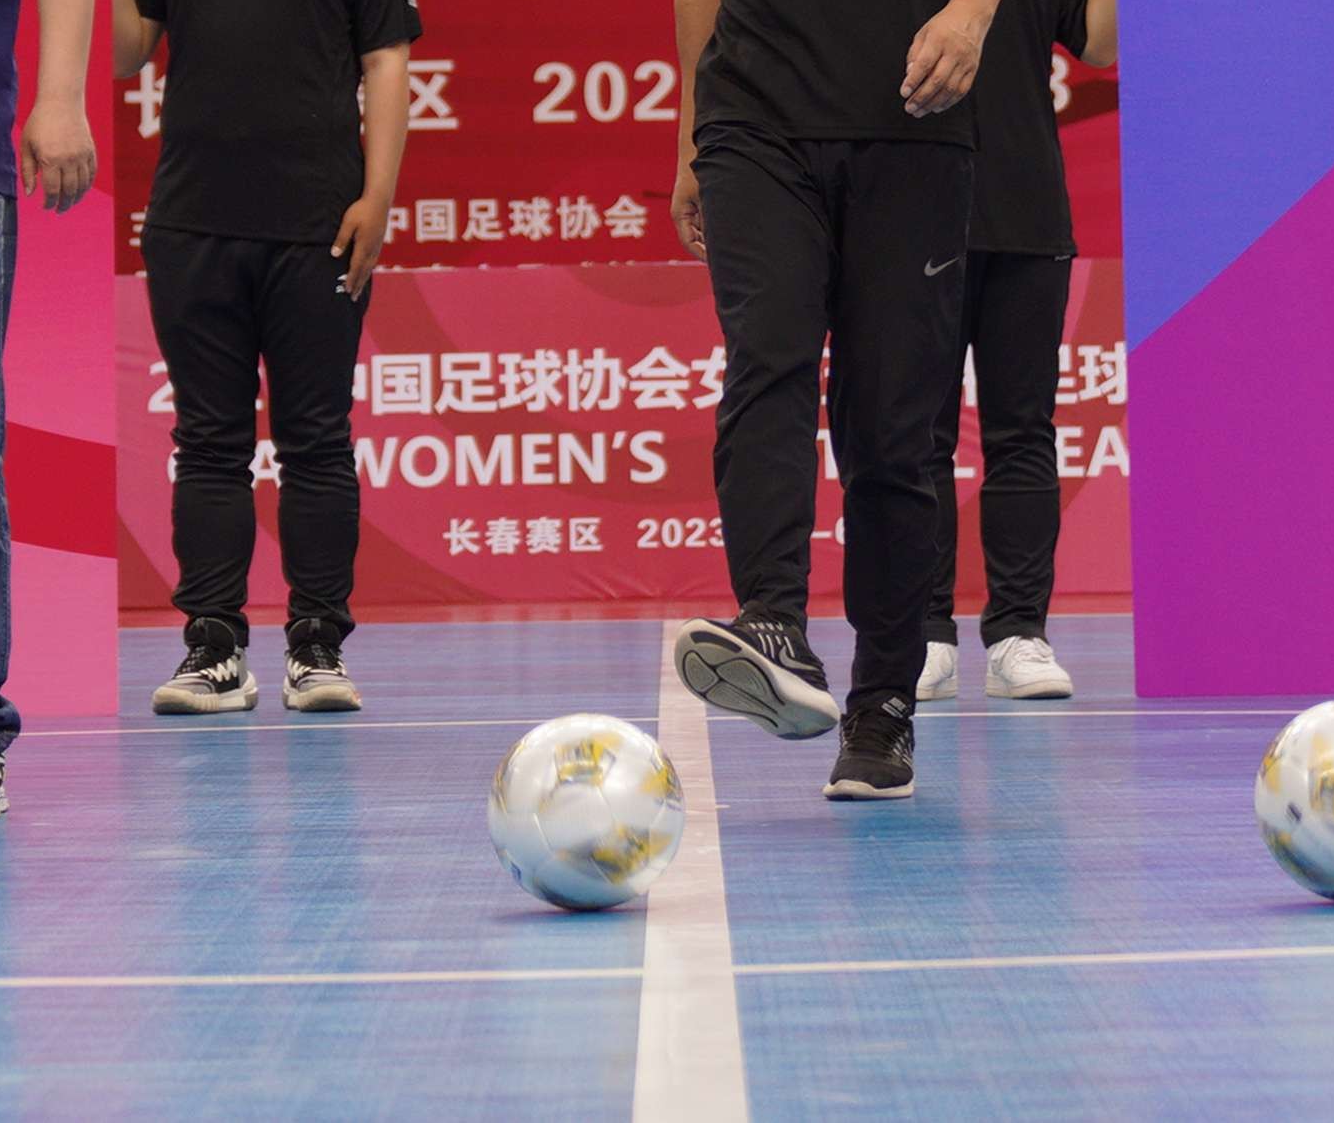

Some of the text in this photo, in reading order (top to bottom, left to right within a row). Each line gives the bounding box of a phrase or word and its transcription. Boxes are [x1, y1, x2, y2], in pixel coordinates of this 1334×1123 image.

[532, 61, 679, 124] 202
[442, 516, 604, 556] 长春赛区
